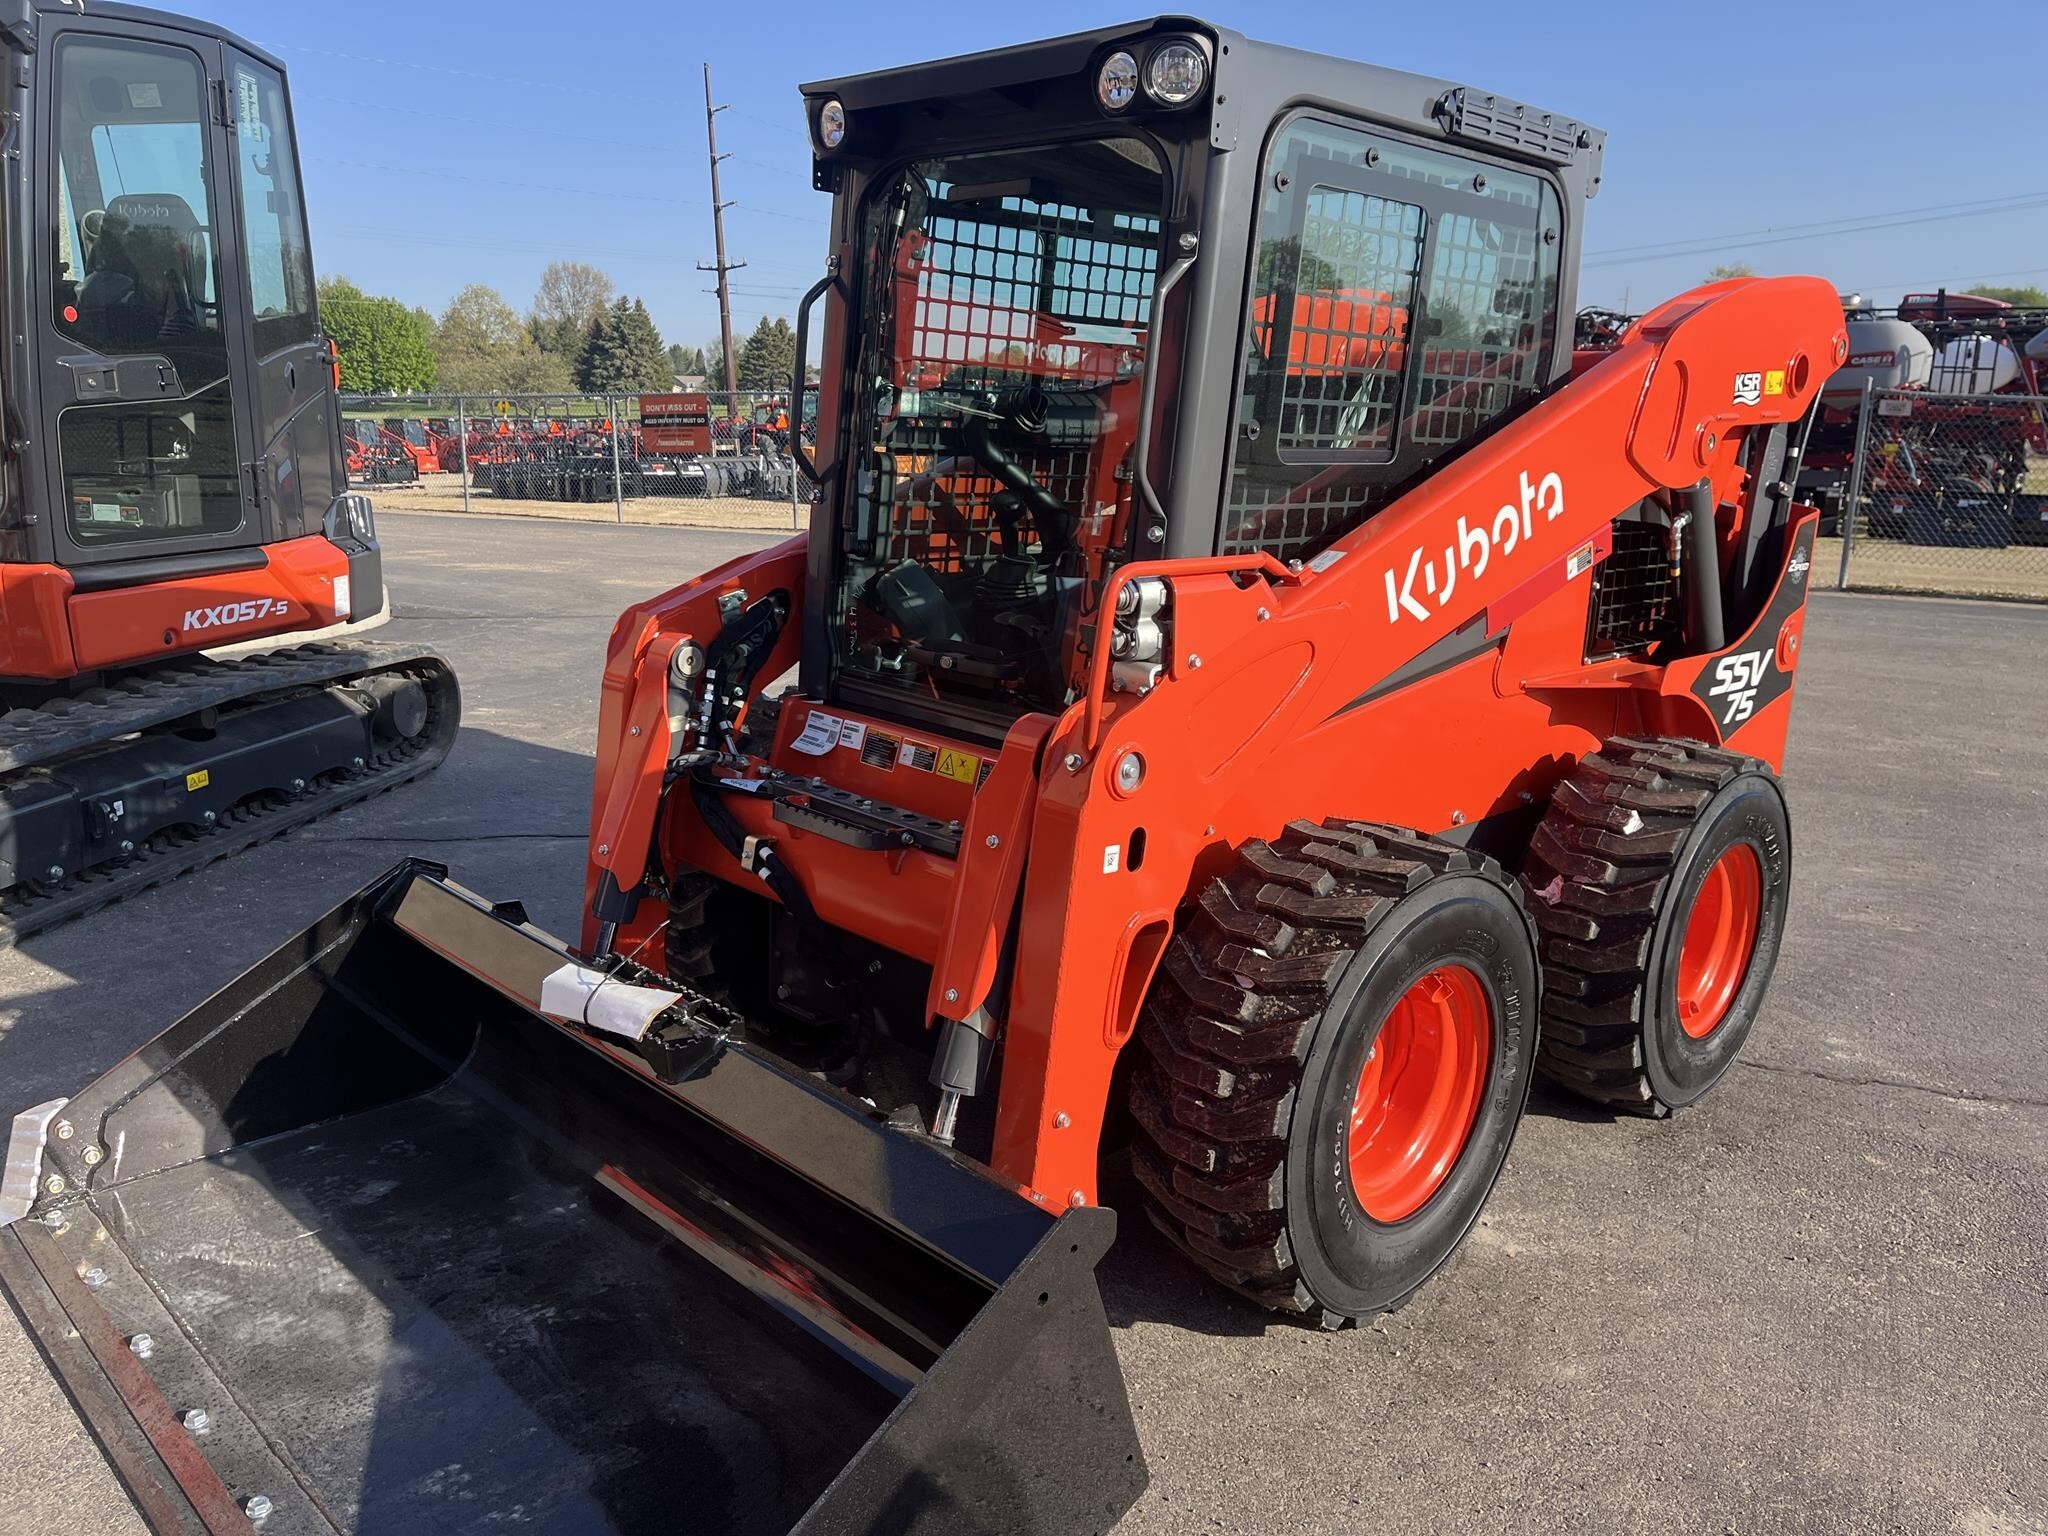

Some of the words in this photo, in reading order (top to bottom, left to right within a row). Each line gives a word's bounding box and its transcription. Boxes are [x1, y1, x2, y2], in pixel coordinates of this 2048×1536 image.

[119, 203, 169, 218] Kubota
[1851, 356, 1881, 365] CASE
[1734, 372, 1761, 391] KSR
[646, 404, 665, 412] DON'T
[684, 403, 697, 411] OUT
[1384, 470, 1564, 624] Kubota
[183, 598, 288, 631] KX057-5
[1708, 648, 1774, 697] SSV
[1722, 688, 1757, 725] 75
